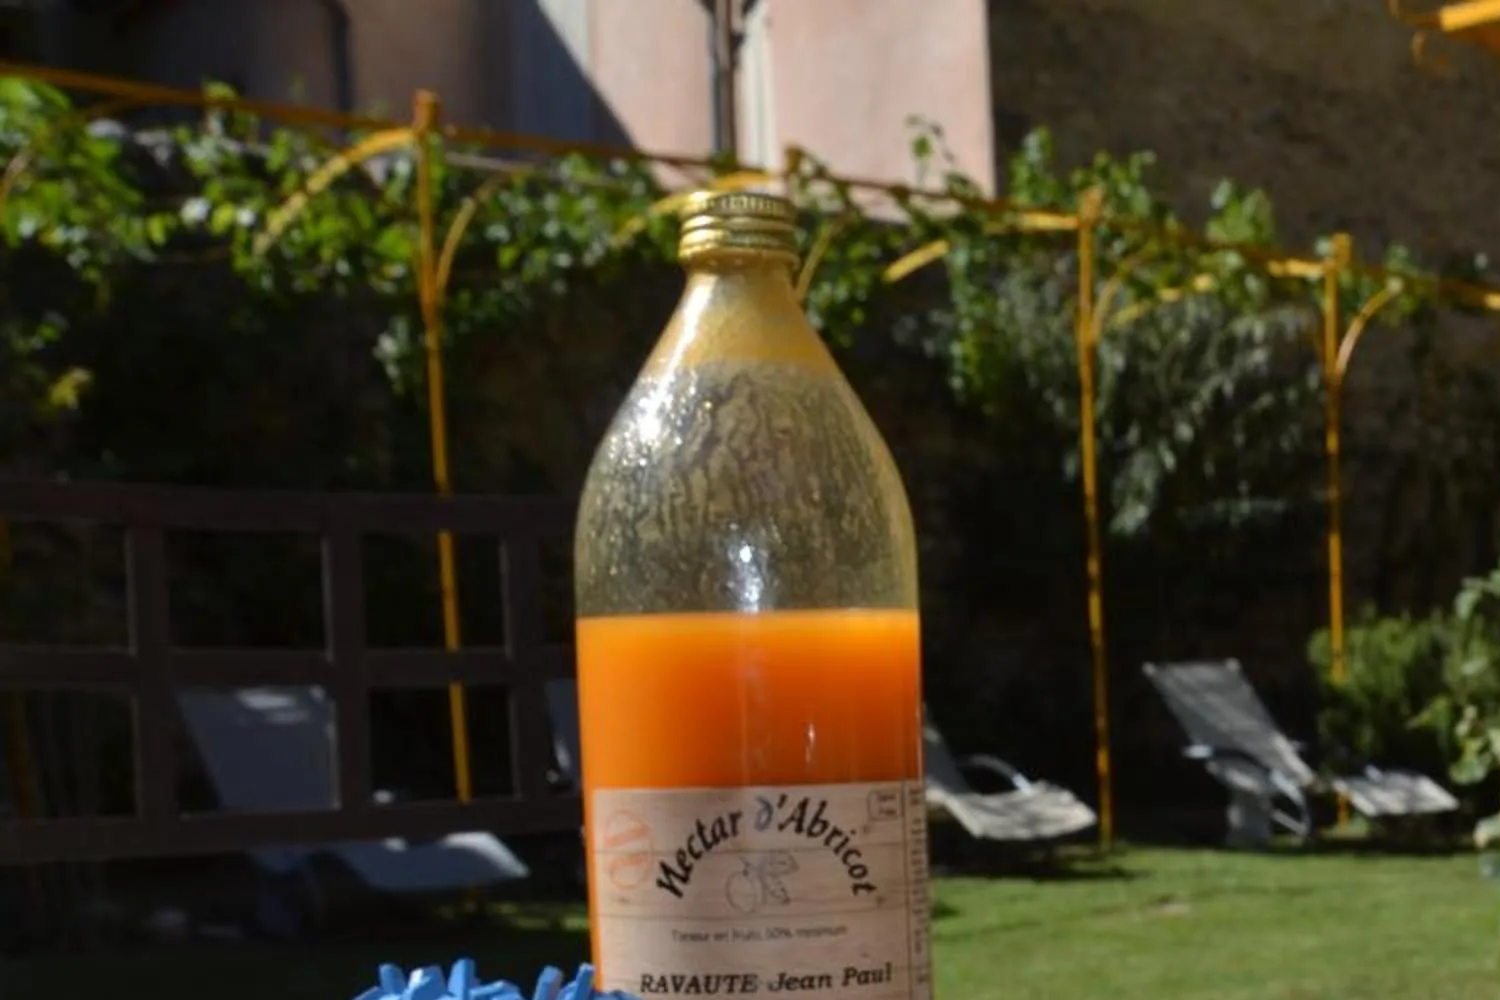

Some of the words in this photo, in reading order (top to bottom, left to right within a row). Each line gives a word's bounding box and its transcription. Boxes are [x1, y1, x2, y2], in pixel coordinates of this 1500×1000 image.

[656, 810, 743, 899] Nectar
[754, 794, 878, 896] d'Abricot
[640, 972, 759, 995] RAVAUTE
[767, 970, 833, 992] Jean
[842, 962, 893, 986] Paul
